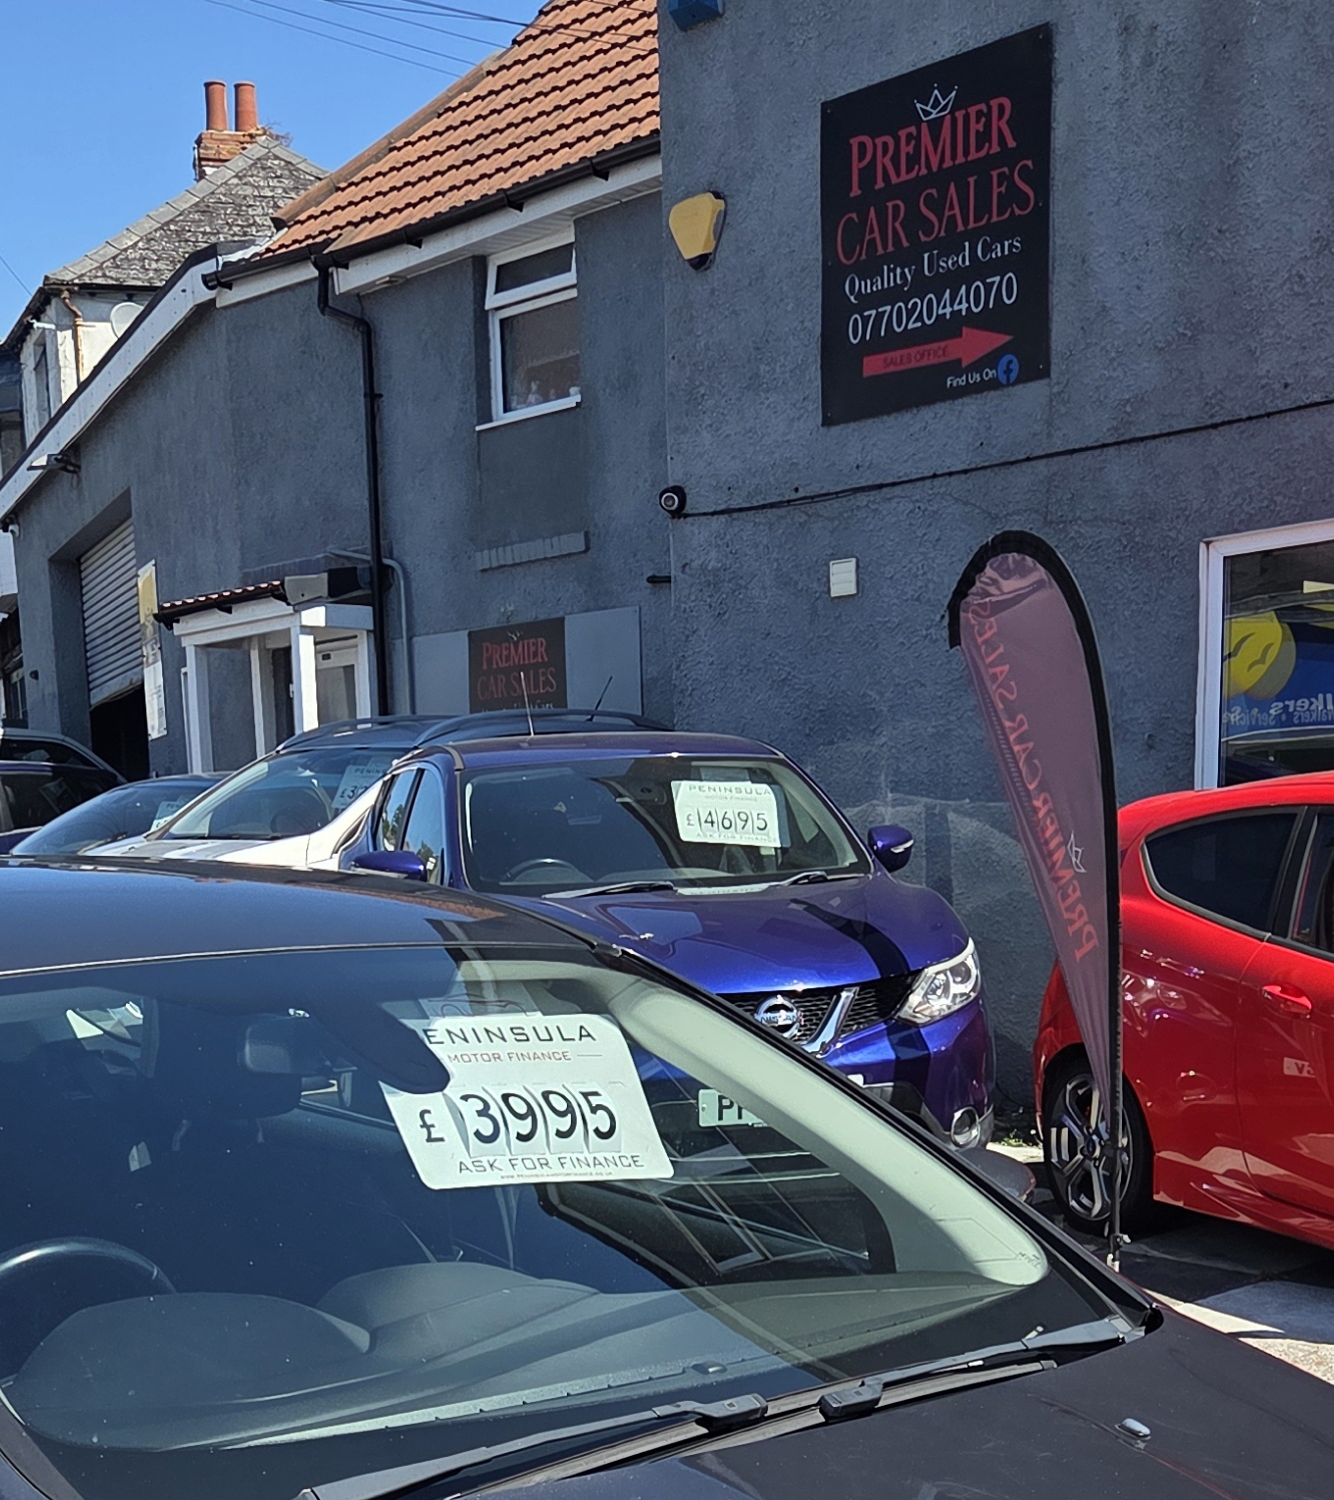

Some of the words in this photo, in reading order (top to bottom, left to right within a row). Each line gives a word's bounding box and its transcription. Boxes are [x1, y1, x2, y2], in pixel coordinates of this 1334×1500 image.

[849, 97, 1017, 197] PREMIER
[836, 200, 909, 265] CAR
[918, 159, 1035, 243] SALES
[844, 264, 915, 303] Quality
[923, 242, 971, 277] Used
[977, 235, 1023, 263] Cars
[848, 272, 1018, 345] 07702044070
[883, 354, 912, 370] SALES
[914, 345, 949, 363] OFFICE
[947, 375, 966, 388] Find
[968, 371, 981, 384] Us
[983, 368, 997, 381] On
[482, 637, 548, 670] PREMIER
[477, 674, 508, 701] CAR
[689, 785, 771, 795] PENINSULA
[422, 1024, 597, 1046] ENINSULA
[447, 1051, 504, 1063] MOTOR
[507, 1050, 572, 1062] FINANCE
[458, 1158, 503, 1174] ASK
[509, 1156, 553, 1171] FOR
[558, 1154, 645, 1169] FINANCE
